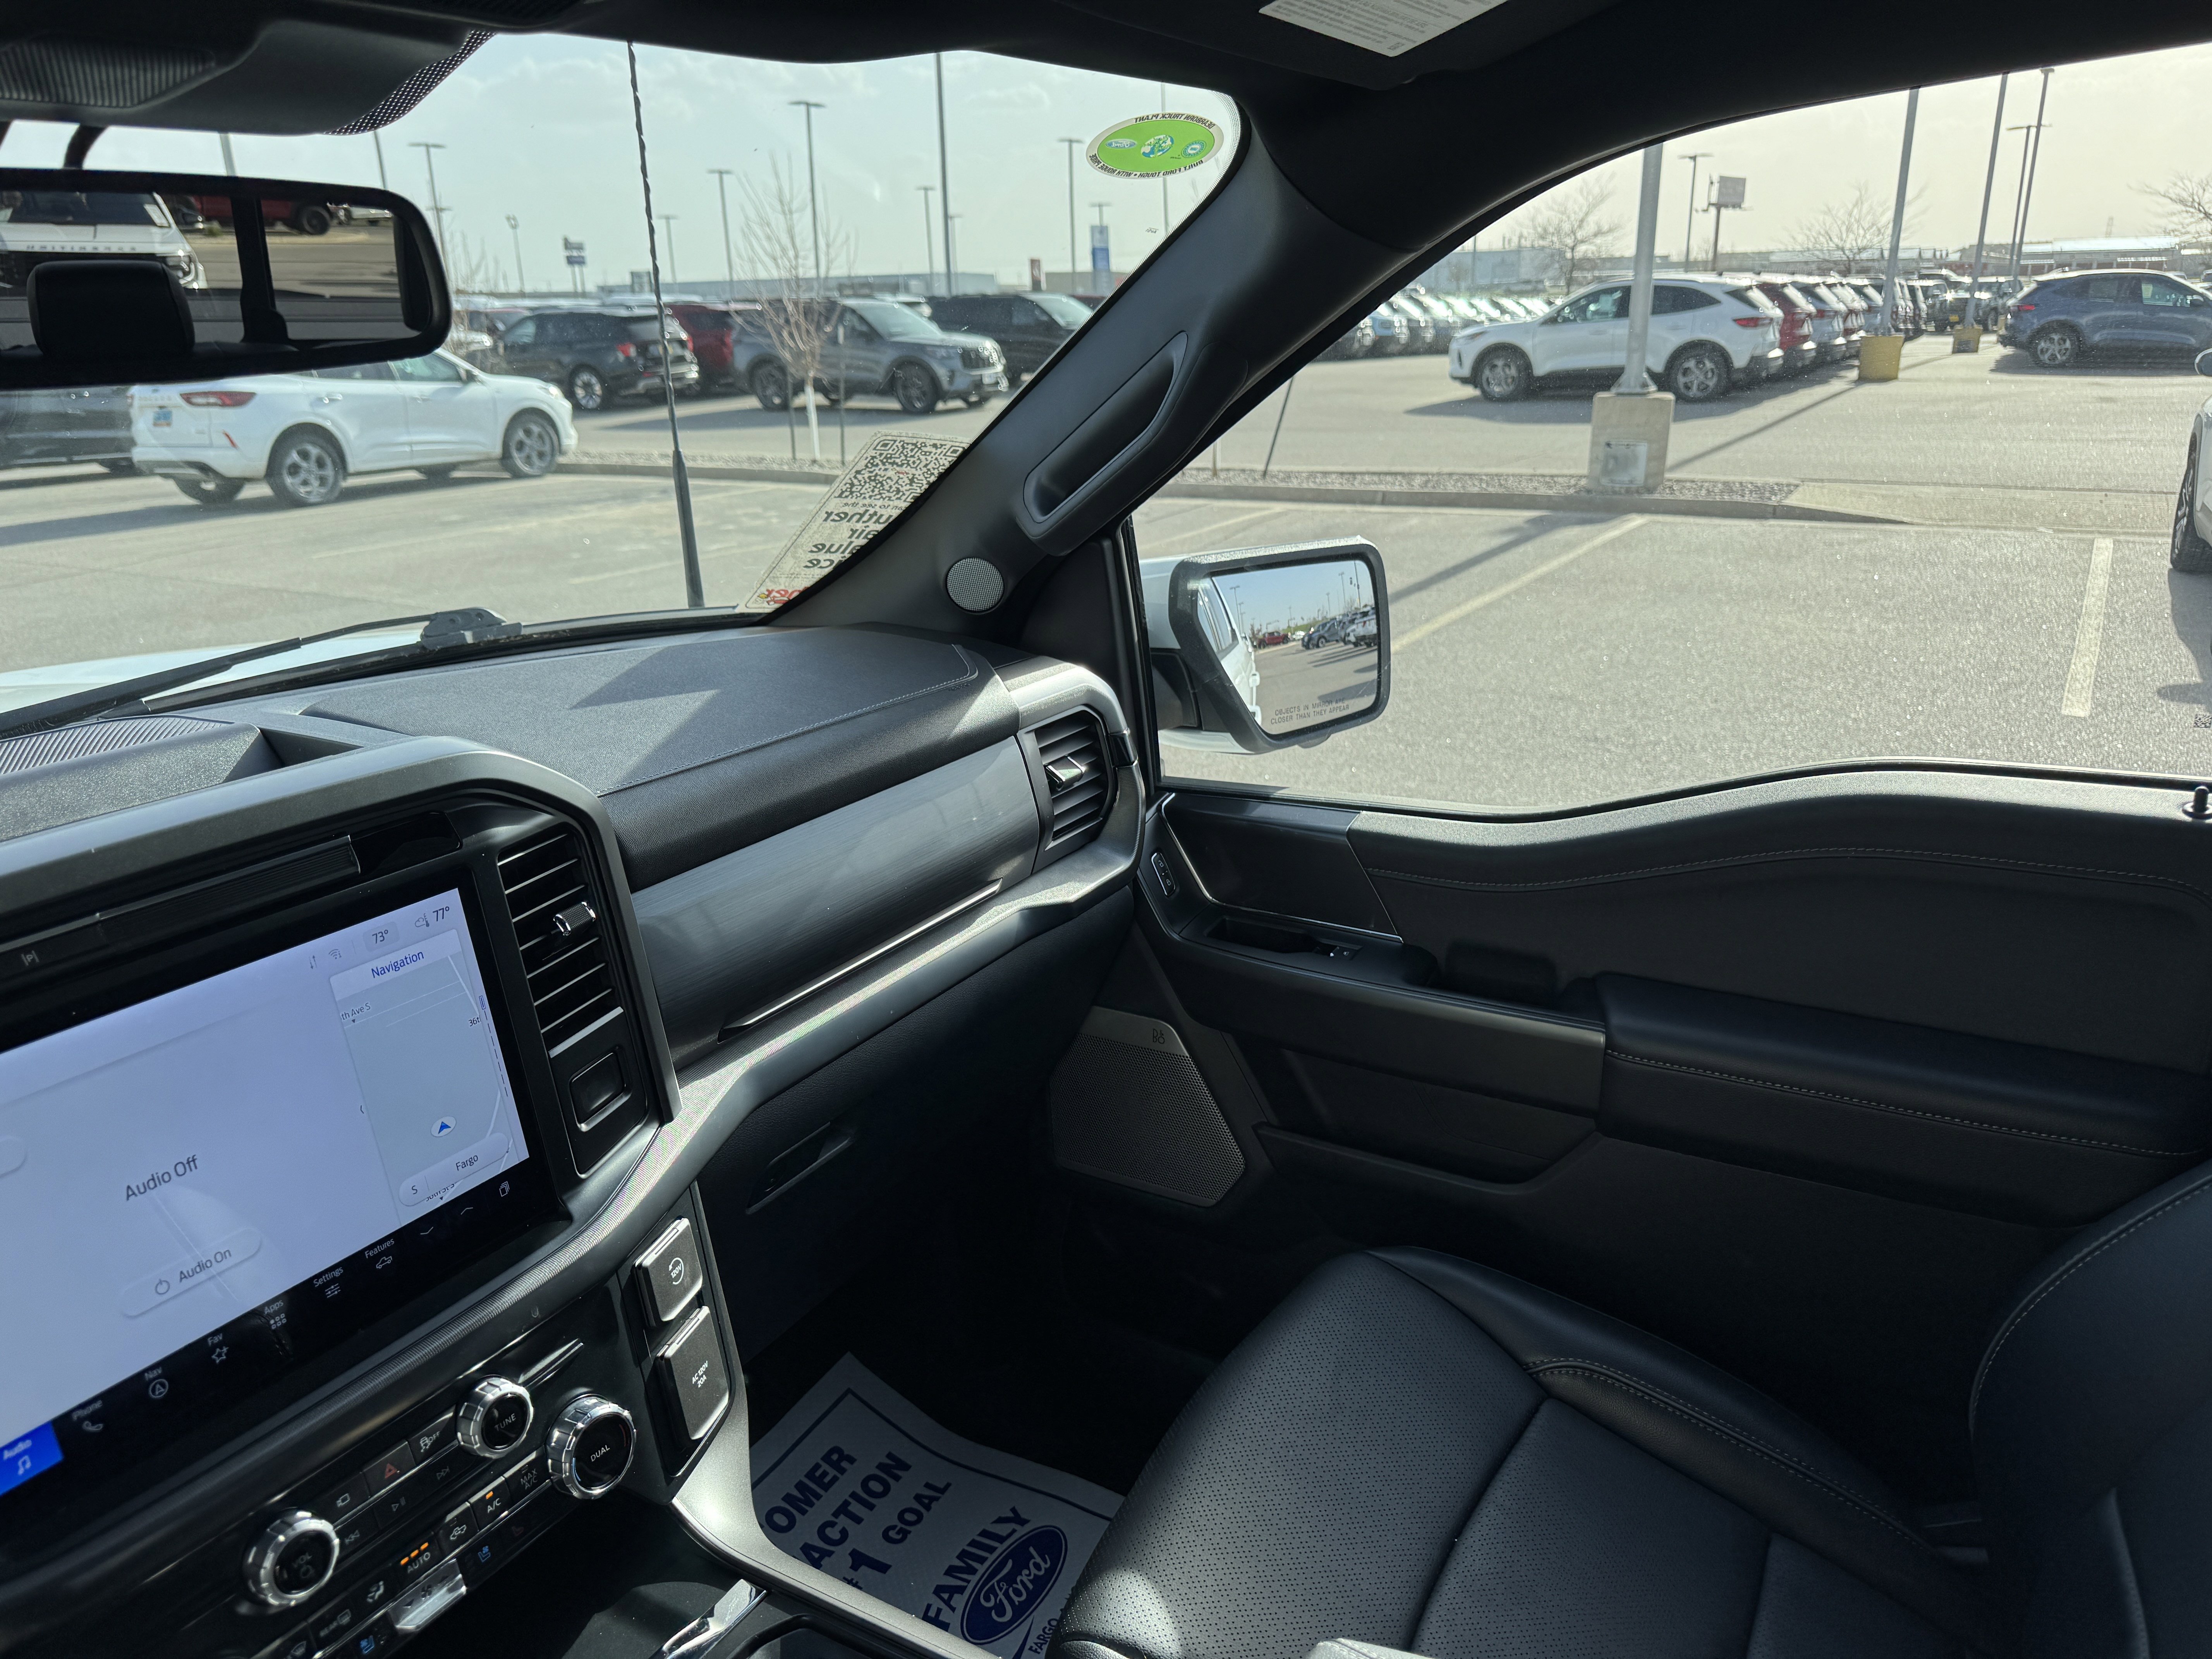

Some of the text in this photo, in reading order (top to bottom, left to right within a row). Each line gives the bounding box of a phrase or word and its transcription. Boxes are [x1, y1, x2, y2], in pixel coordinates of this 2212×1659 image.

[1271, 715, 1293, 725] CLOSER
[1296, 712, 1310, 720] THAN
[1329, 704, 1350, 713] APPEAR
[1275, 706, 1300, 716] OBJECTS
[1312, 700, 1333, 709] MIRROR
[432, 906, 450, 922] 77°
[372, 929, 388, 944] 73°
[371, 951, 424, 978] Navigation
[351, 1006, 365, 1017] Ave
[365, 1002, 371, 1010] S
[455, 1155, 479, 1171] Fargo
[125, 1154, 198, 1201] Audio Off
[411, 1185, 418, 1195] S
[364, 1238, 395, 1259] Features
[179, 1249, 232, 1283] Audio On
[670, 1263, 682, 1279] 120V
[313, 1267, 343, 1287] Settings
[263, 1300, 284, 1315] Apps
[207, 1333, 223, 1346] Fav
[144, 1366, 163, 1381] Nav
[692, 1360, 708, 1384] AC 120V
[697, 1374, 707, 1388] 20A
[72, 1399, 104, 1421] Phone
[494, 1413, 517, 1432] TUNE
[428, 1431, 441, 1443] OFF
[3, 1439, 33, 1461] Audio
[591, 1444, 610, 1462] DUAL
[520, 1468, 538, 1485] MAX
[525, 1475, 538, 1490] A/C
[759, 1445, 857, 1534] OMER
[487, 1498, 501, 1513] A/C
[796, 1451, 912, 1570] ACTION
[882, 1479, 952, 1545] GOAL
[407, 1552, 431, 1574] AUTO
[922, 1505, 1031, 1632] FAMILY
[979, 1546, 1051, 1623] Ford
[1028, 1618, 1058, 1654] FARGO
